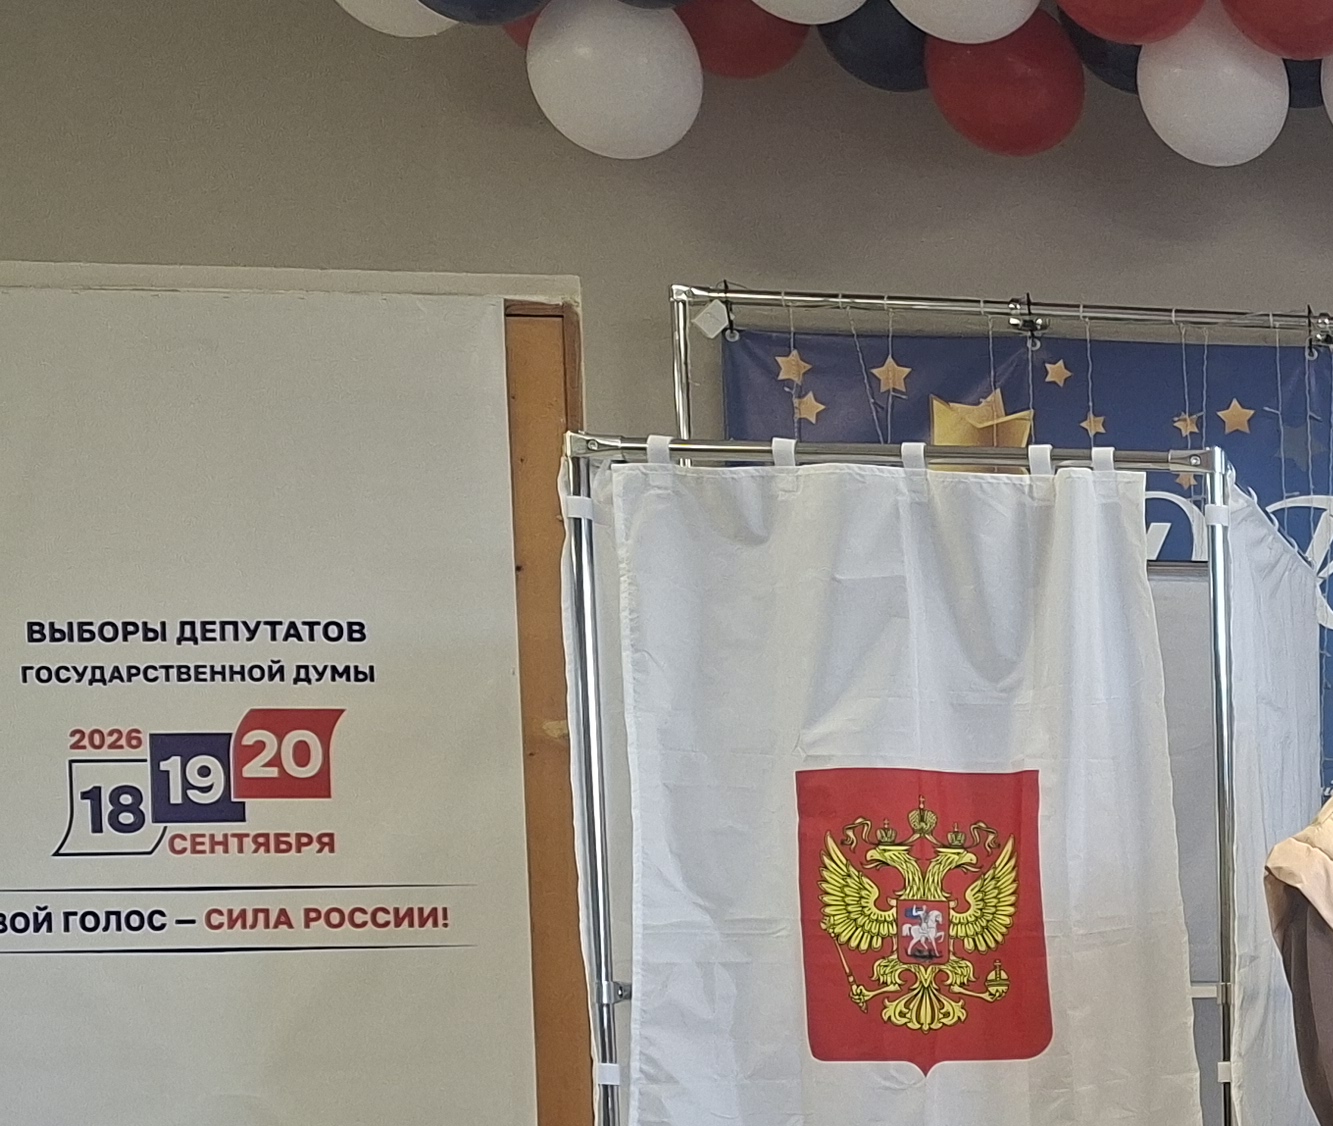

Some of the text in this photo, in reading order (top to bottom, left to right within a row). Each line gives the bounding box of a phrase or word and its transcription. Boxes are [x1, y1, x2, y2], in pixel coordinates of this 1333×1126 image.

[26, 620, 367, 647] ВЫБОРЫ ДЕПУТАТОВ
[20, 659, 376, 686] ГОСУДАРСТВЕННОЙ ДУМЫ
[69, 728, 143, 751] 2026
[80, 730, 323, 834] 18 19 20
[167, 830, 336, 856] СЕНТЯБРЯ
[62, 909, 167, 932] ГОЛОС
[204, 906, 295, 931] СИЛА
[302, 905, 450, 930] РОССИИ!
